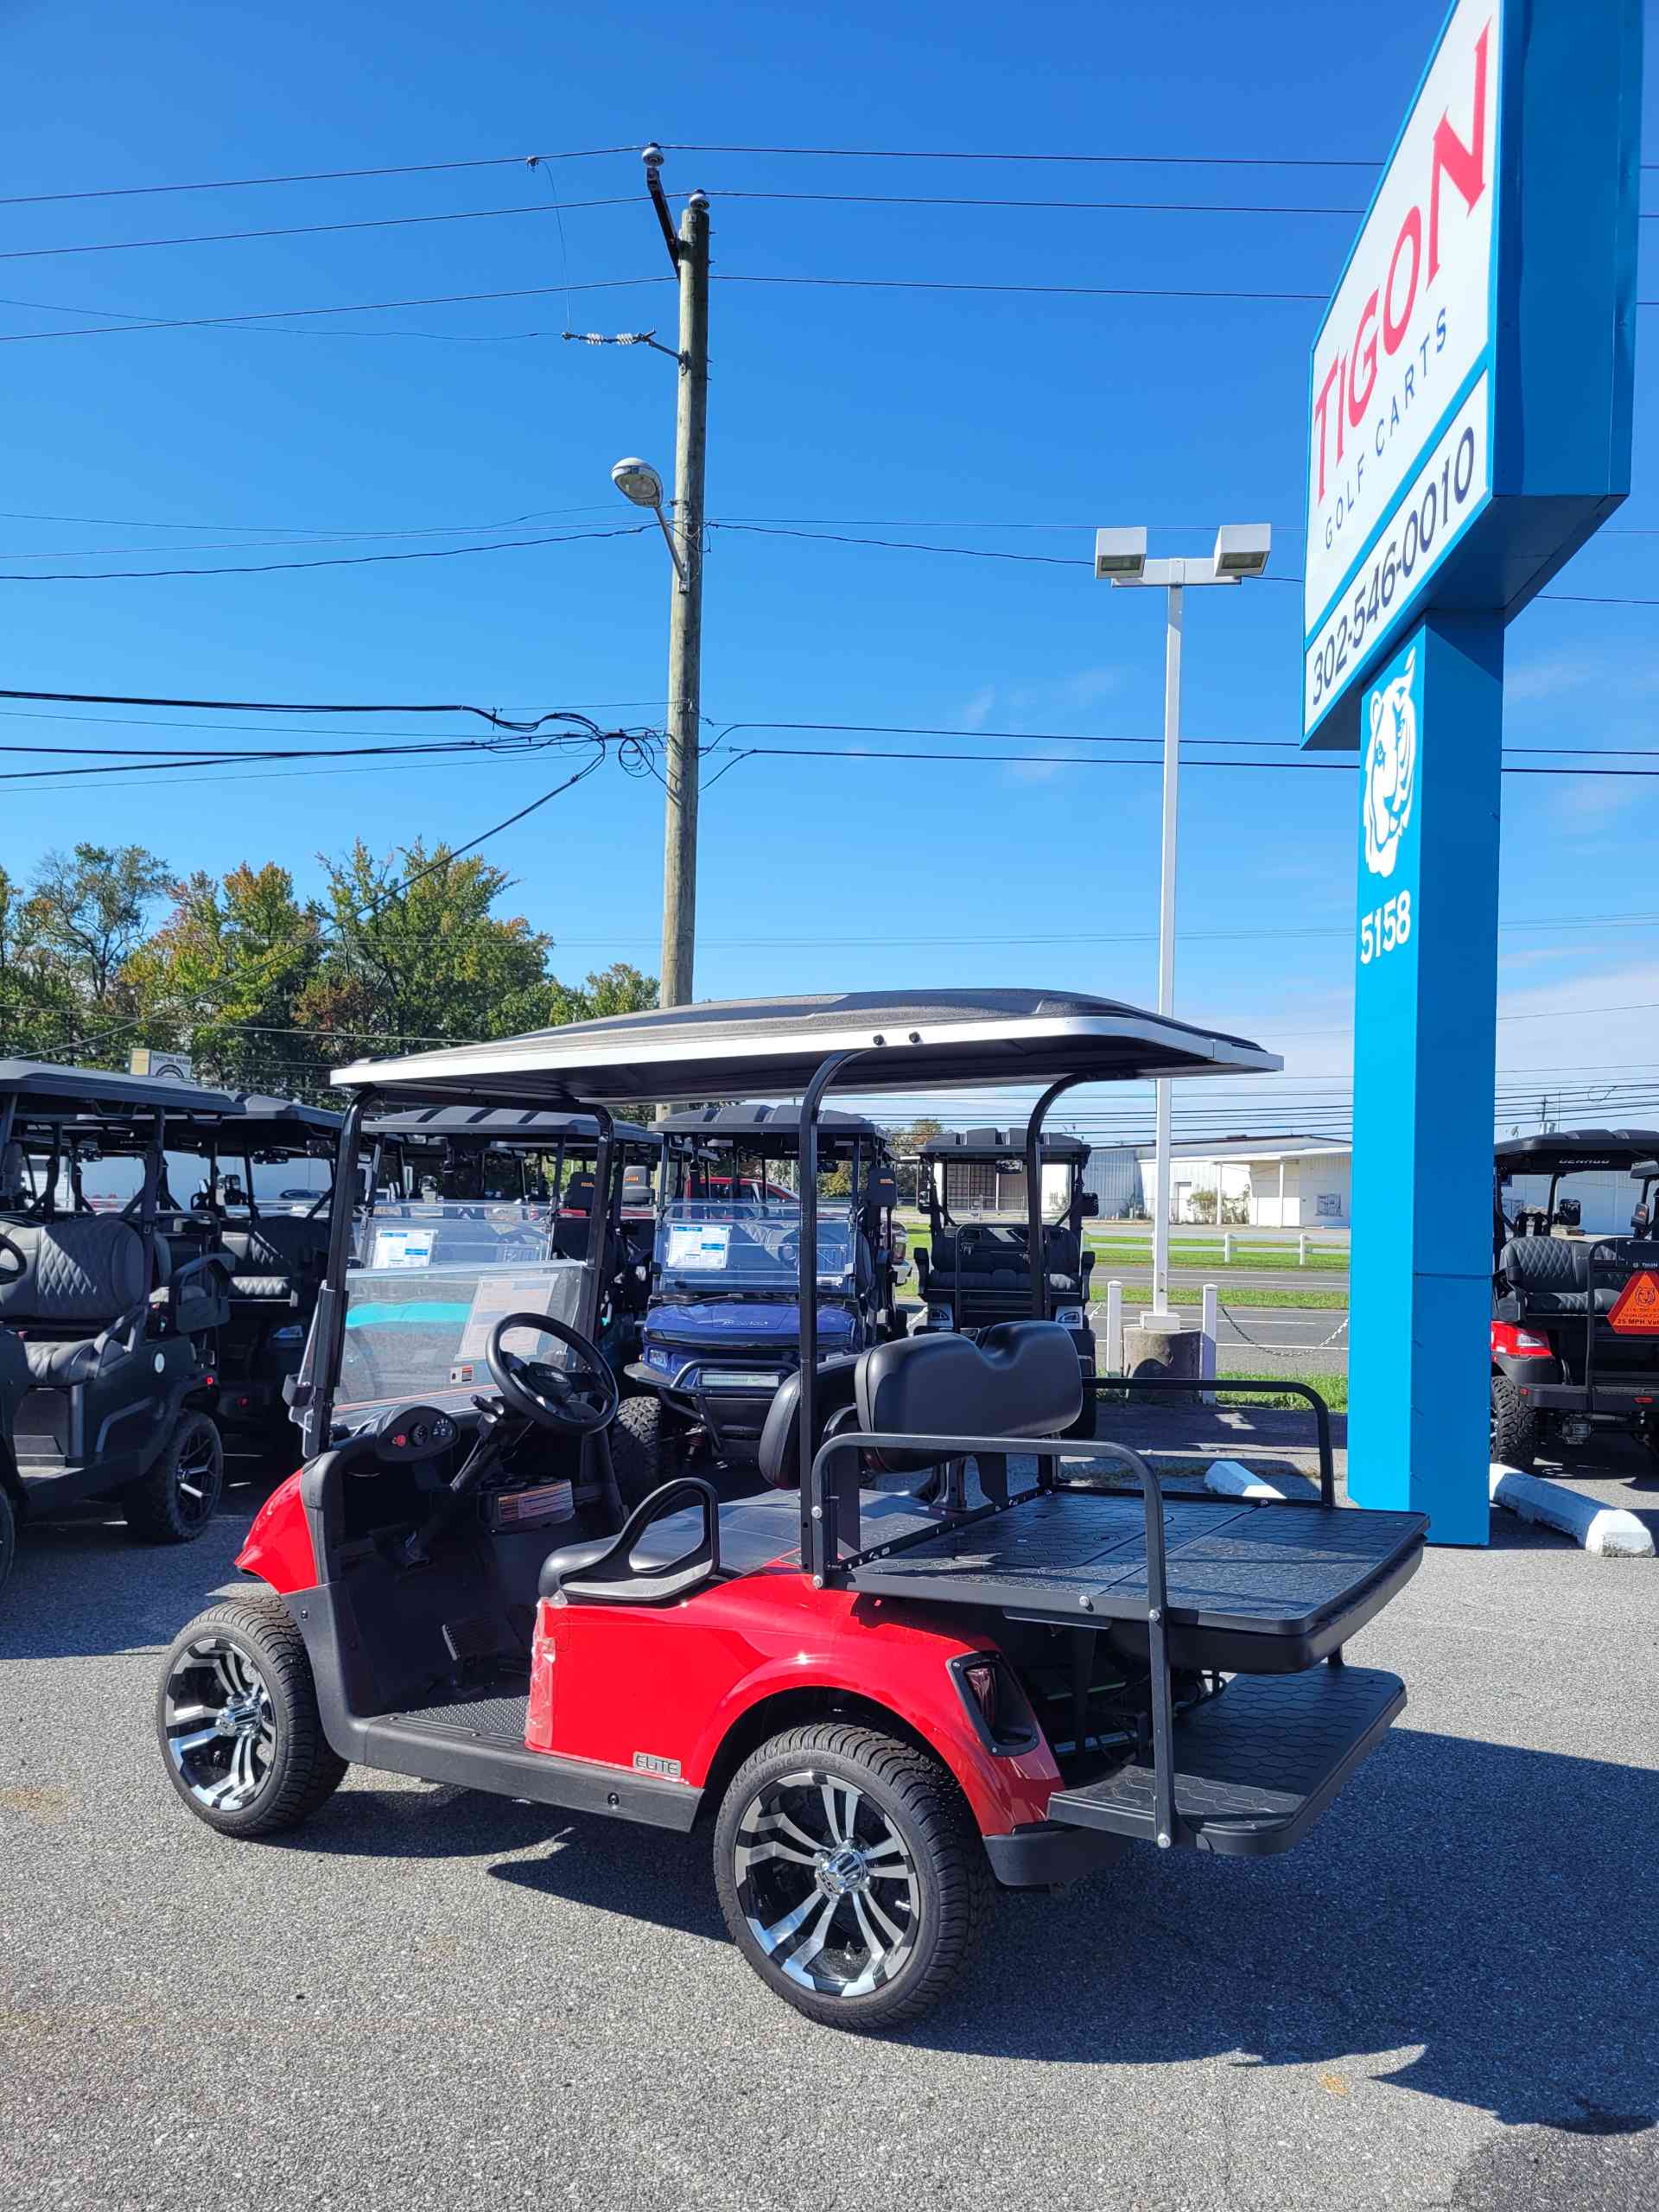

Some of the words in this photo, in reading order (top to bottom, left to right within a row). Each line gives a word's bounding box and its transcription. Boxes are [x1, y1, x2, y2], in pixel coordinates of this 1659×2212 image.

[1314, 15, 1491, 508] TIGON
[1325, 452, 1364, 550] GOLF
[1376, 307, 1446, 457] CARTS
[1313, 426, 1475, 706] 302-546-0010
[1360, 889, 1411, 964] 5158
[636, 1754, 679, 1776] ELITE
